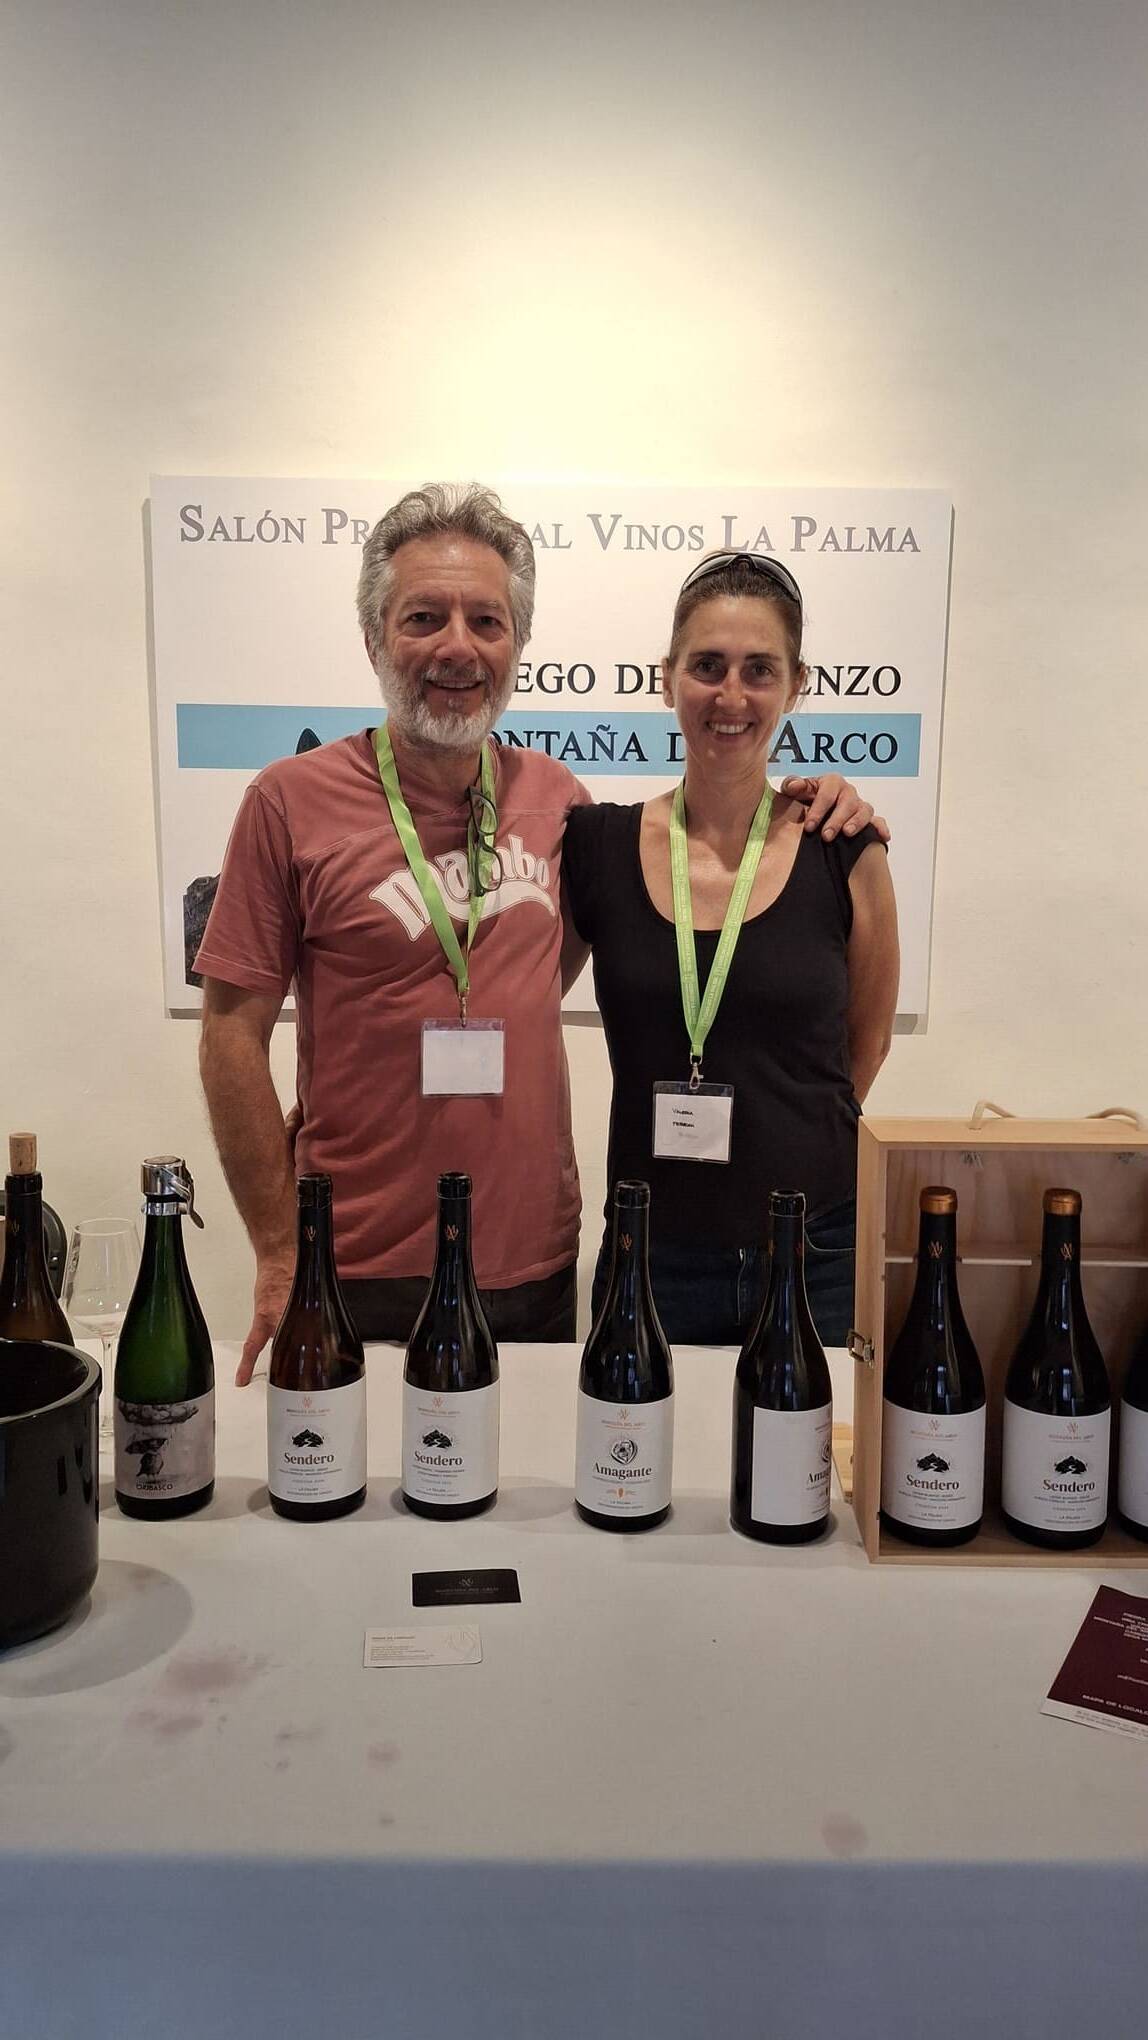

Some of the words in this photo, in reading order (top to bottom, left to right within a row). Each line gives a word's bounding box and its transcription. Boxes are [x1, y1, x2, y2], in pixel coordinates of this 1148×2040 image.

[179, 504, 306, 543] SALÓN
[586, 513, 704, 551] VINOS
[720, 515, 776, 552] LA
[790, 516, 921, 553] PALMA
[515, 662, 596, 695] EGO
[767, 719, 898, 764] ARCO
[284, 1452, 335, 1465] Sendero
[414, 1450, 463, 1466] Sendero
[593, 1461, 652, 1480] Amagante
[906, 1473, 960, 1491] Sendero
[1042, 1479, 1096, 1493] Sendero
